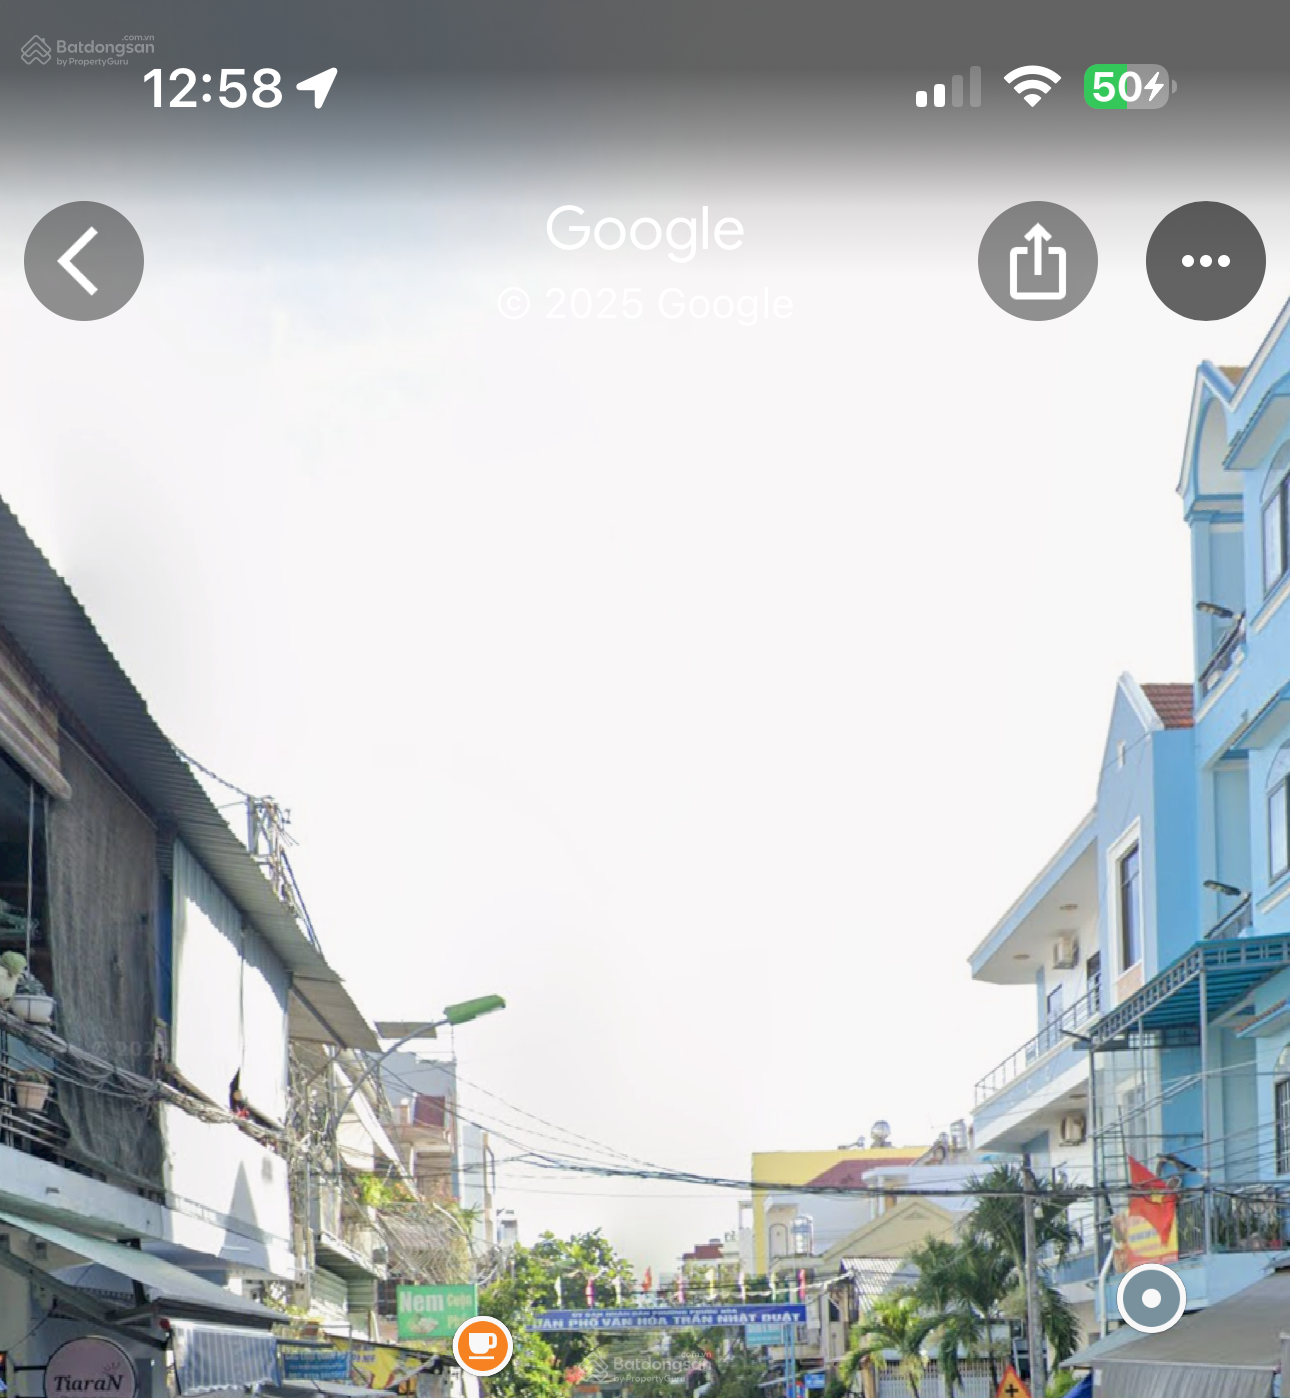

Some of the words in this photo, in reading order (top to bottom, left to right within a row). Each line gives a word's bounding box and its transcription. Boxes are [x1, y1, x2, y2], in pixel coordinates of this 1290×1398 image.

[144, 67, 283, 109] 12:58
[1093, 71, 1142, 103] 50
[400, 1291, 444, 1313] Nem
[54, 1374, 124, 1391] TiaraN
